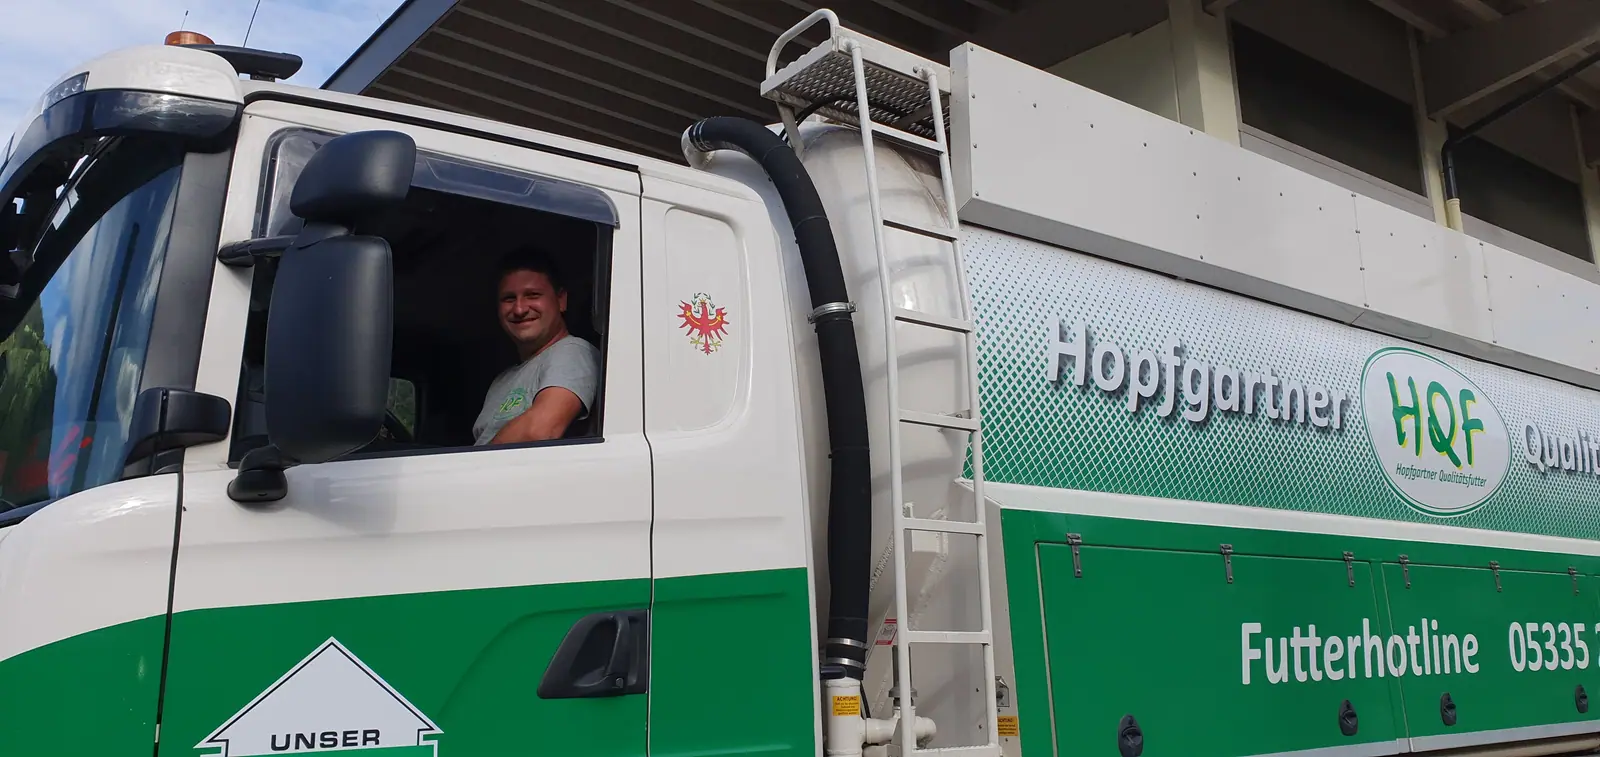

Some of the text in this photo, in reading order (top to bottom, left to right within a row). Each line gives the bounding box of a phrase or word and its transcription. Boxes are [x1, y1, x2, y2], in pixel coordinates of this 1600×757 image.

[1047, 317, 1349, 430] Hopfgartner
[1386, 371, 1485, 469] HQF
[1396, 463, 1487, 488] Hopfgartner Qualitätsfutter
[1241, 618, 1480, 685] Futterhotline
[1508, 621, 1590, 672] 05335
[271, 729, 380, 751] UNSER
